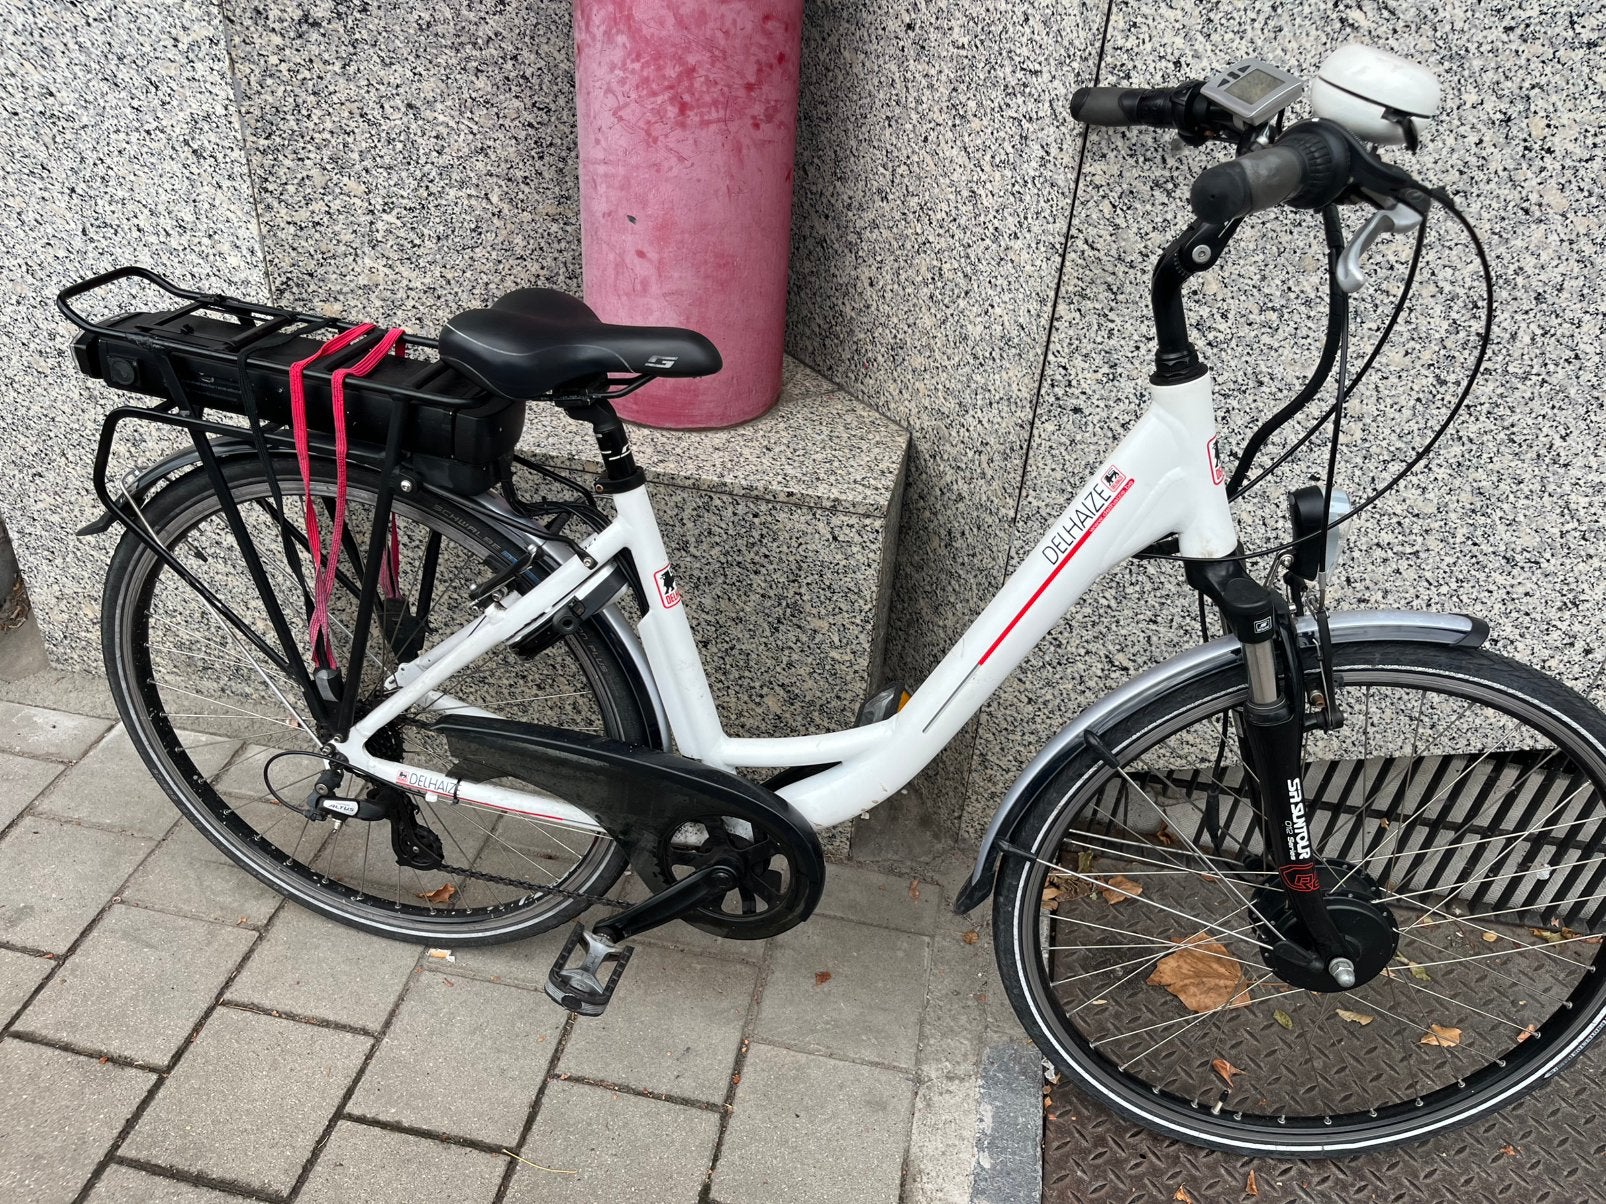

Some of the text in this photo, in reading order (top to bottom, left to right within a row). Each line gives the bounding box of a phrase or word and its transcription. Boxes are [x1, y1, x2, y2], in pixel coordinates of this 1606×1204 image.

[433, 504, 502, 549] SCHWALBE
[1041, 483, 1112, 565] DELHAIZE
[409, 772, 463, 797] DELHAIZE
[328, 803, 355, 812] ALTUS
[1287, 836, 1297, 861] Series
[1291, 802, 1311, 860] SUNTOUR
